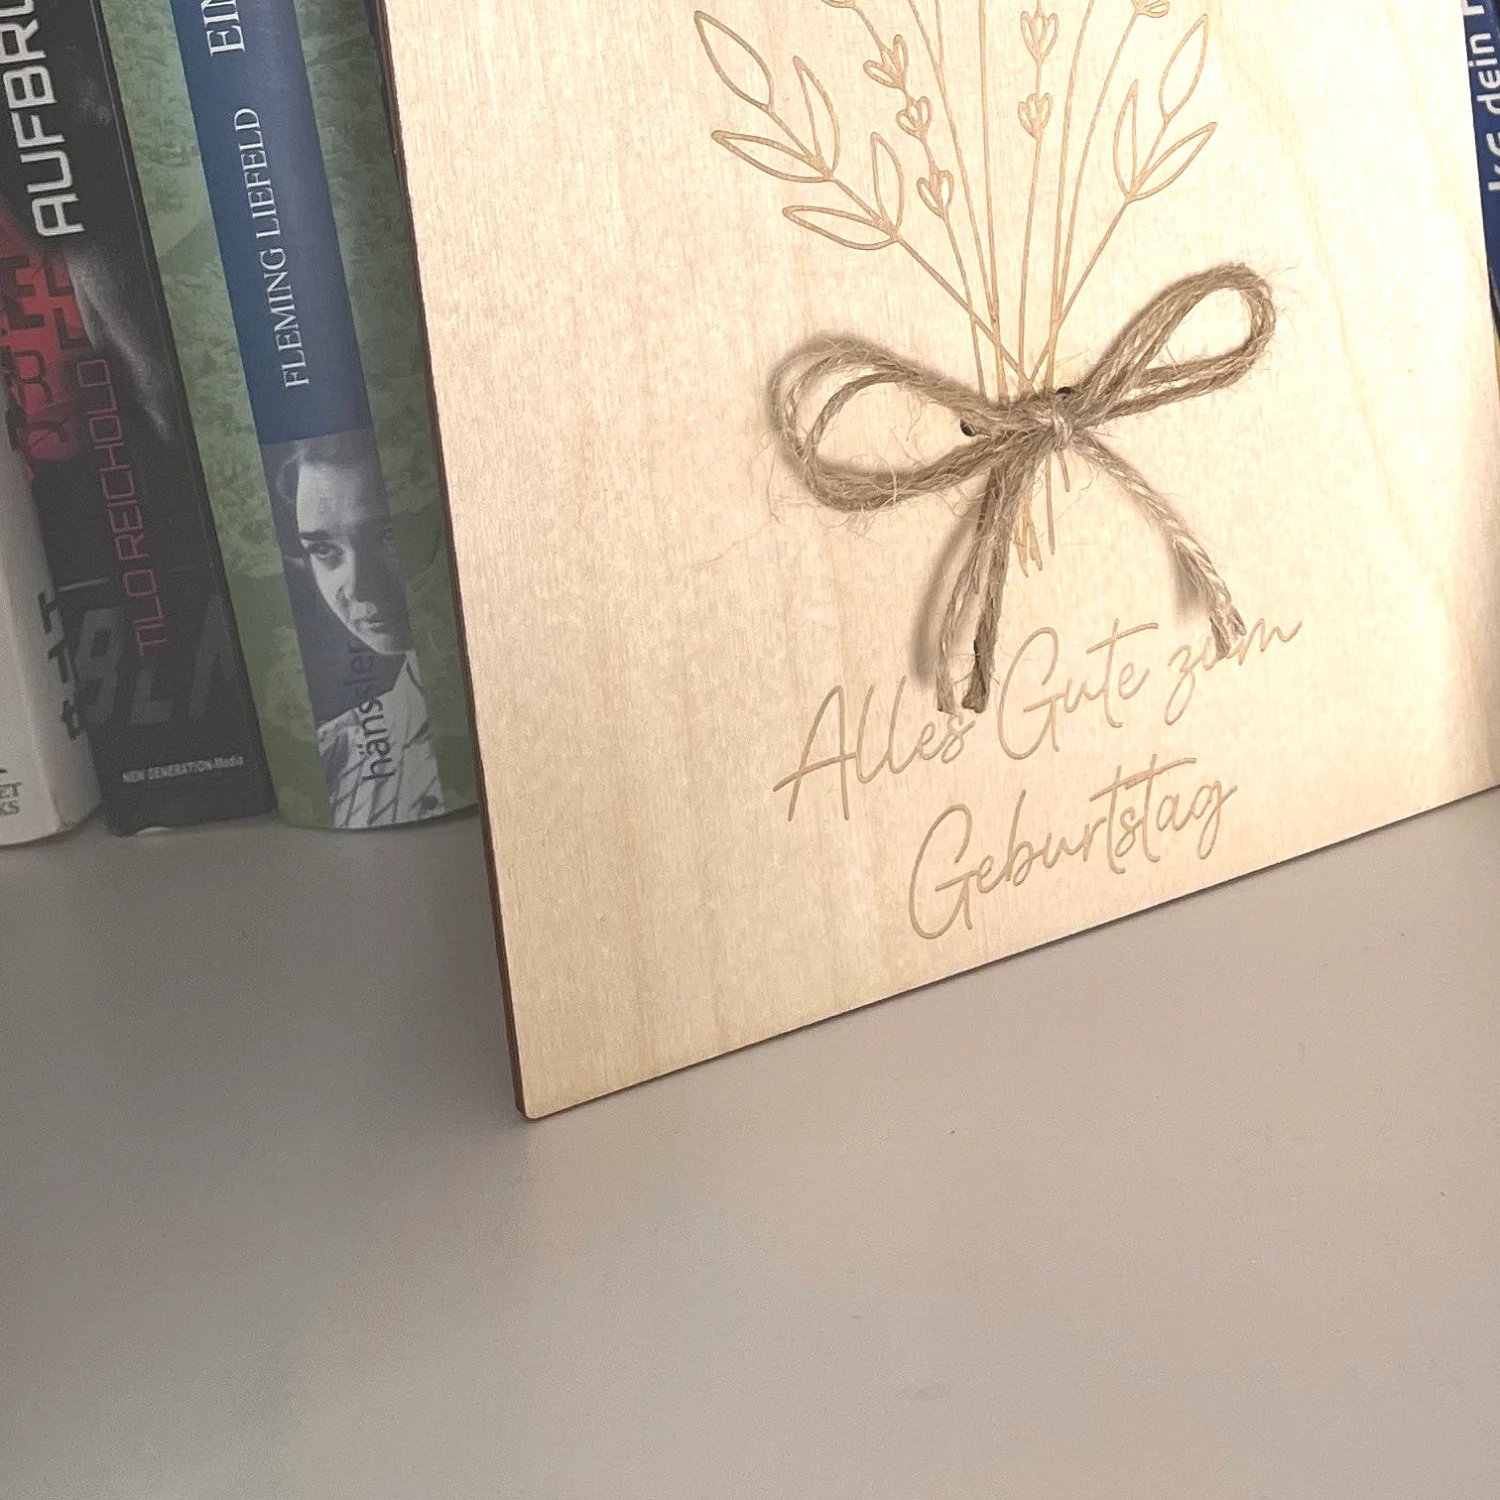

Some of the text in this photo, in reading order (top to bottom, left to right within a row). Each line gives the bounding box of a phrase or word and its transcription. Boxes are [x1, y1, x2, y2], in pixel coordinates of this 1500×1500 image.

[234, 107, 310, 388] FLEMING LIEFELD
[123, 569, 168, 656] TILO
[772, 676, 978, 822] Alles
[998, 617, 1160, 762] Gute
[908, 752, 1238, 940] Geburtstag
